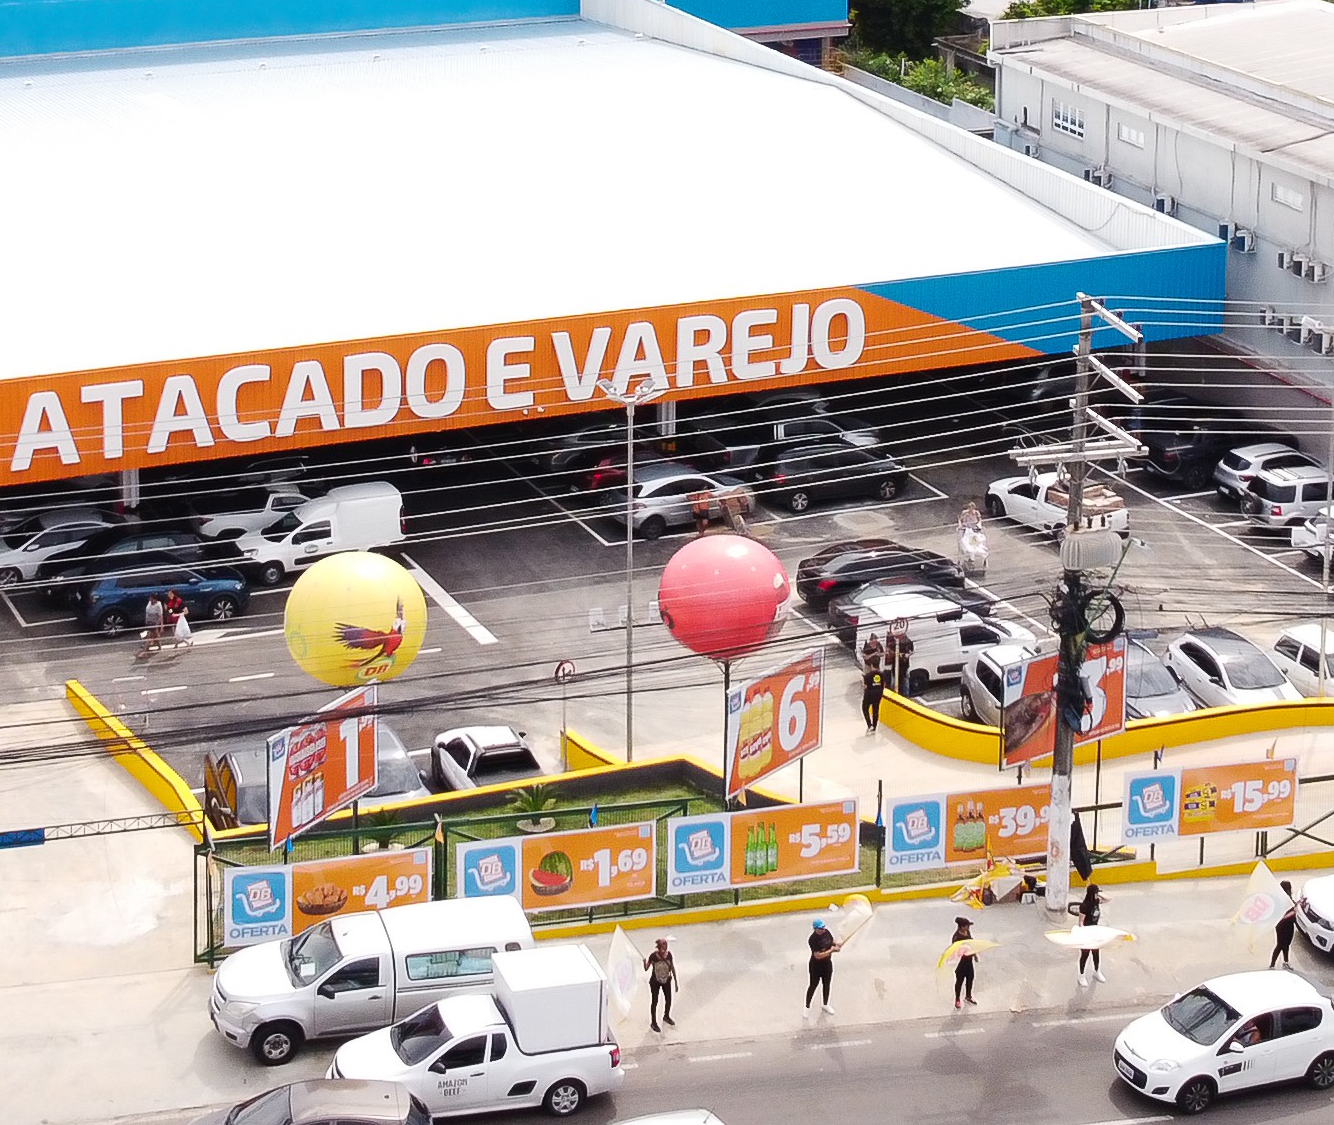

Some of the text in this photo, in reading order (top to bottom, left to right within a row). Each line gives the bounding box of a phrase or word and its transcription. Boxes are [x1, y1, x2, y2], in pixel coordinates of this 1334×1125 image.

[11, 298, 867, 472] ATACADO E VAREJO
[894, 620, 905, 630] 20
[1144, 789, 1163, 803] DB
[908, 815, 928, 830] DB
[1125, 824, 1175, 838] OFERTA
[889, 850, 942, 866] OFERTA
[481, 861, 502, 875] DB
[672, 872, 727, 887] OFERTA
[249, 887, 272, 901] DB
[230, 924, 288, 939] OFERTA
